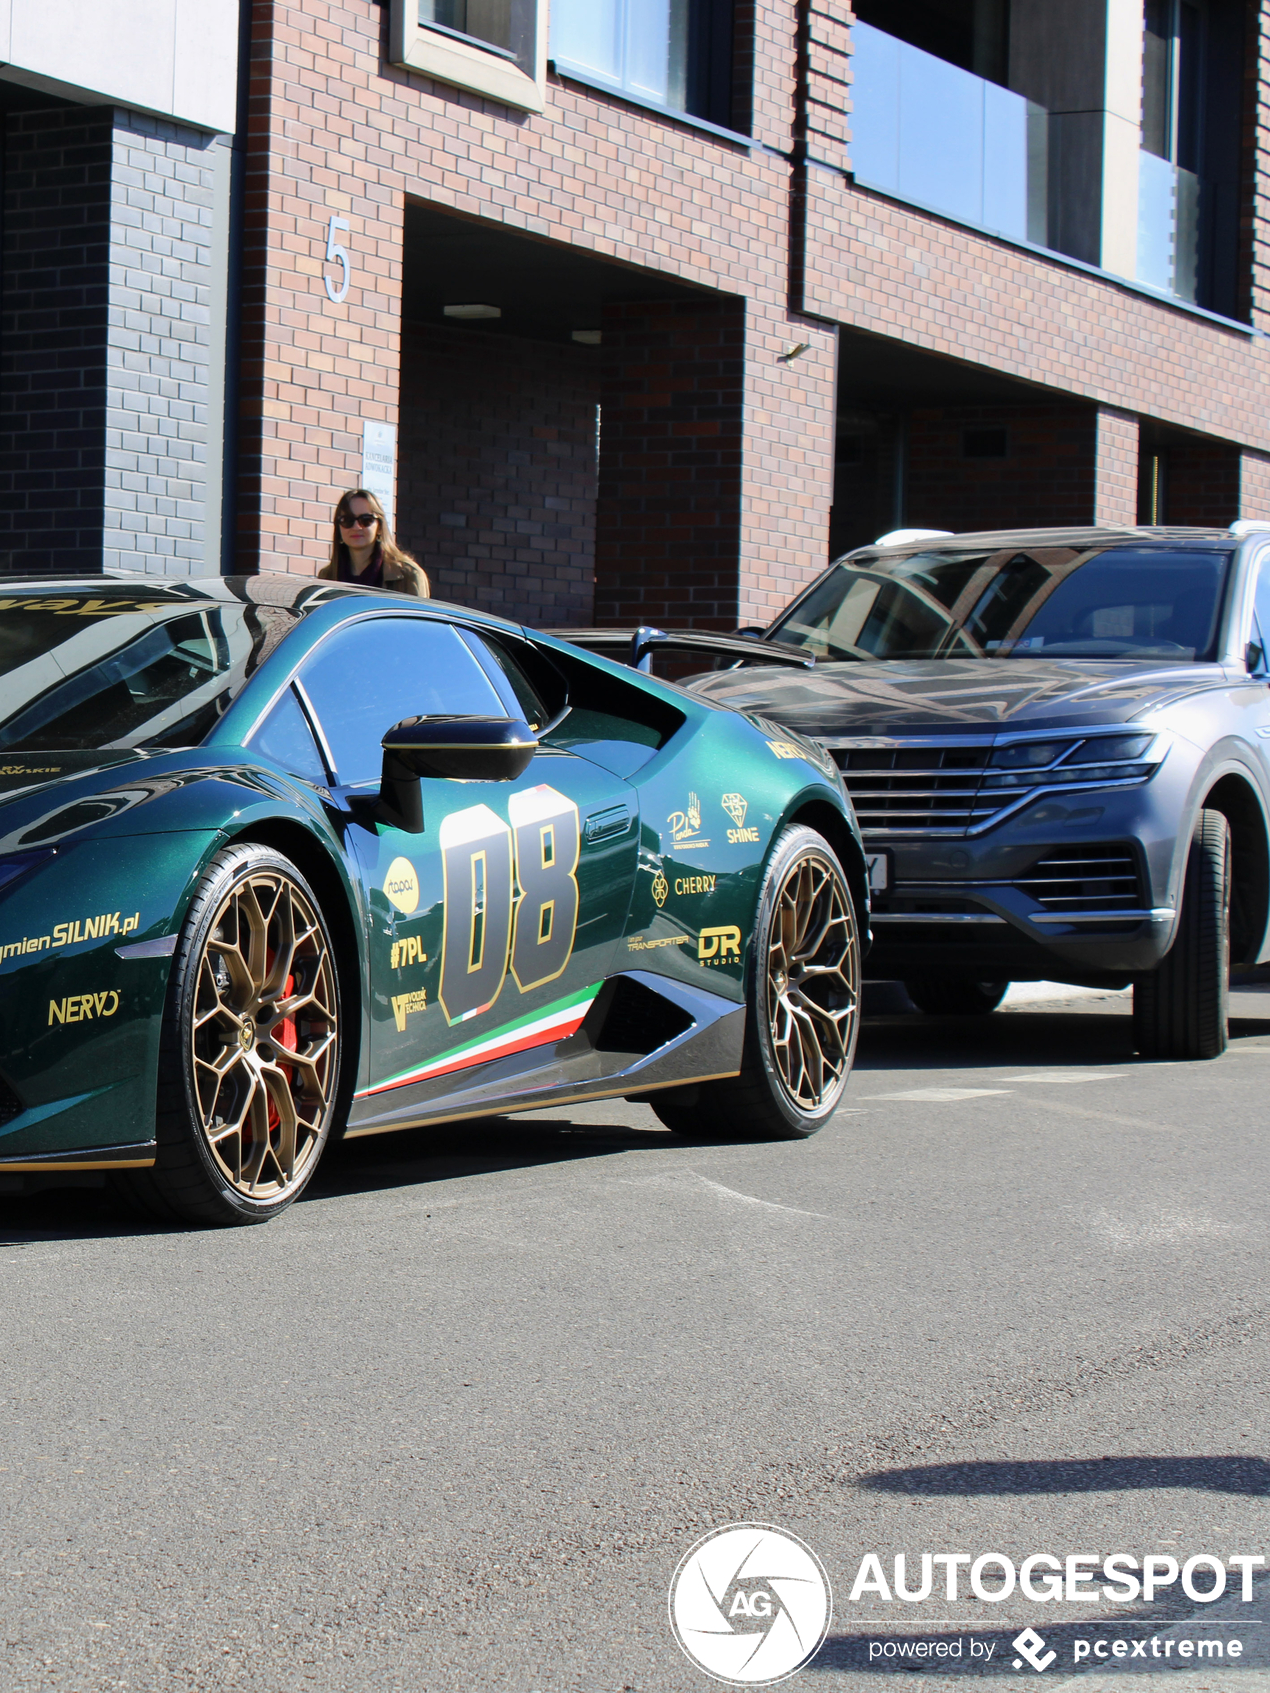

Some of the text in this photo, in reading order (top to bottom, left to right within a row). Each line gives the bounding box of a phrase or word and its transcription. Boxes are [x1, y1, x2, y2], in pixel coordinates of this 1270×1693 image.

[325, 215, 351, 304] 5
[726, 827, 760, 843] SHINE
[674, 874, 717, 896] CHERRY
[438, 783, 581, 1028] 08
[390, 935, 428, 970] #7PL
[627, 935, 690, 952] TRANSPORTER
[697, 924, 742, 959] DR
[699, 956, 741, 967] STUDIO
[47, 990, 121, 1026] NERVO
